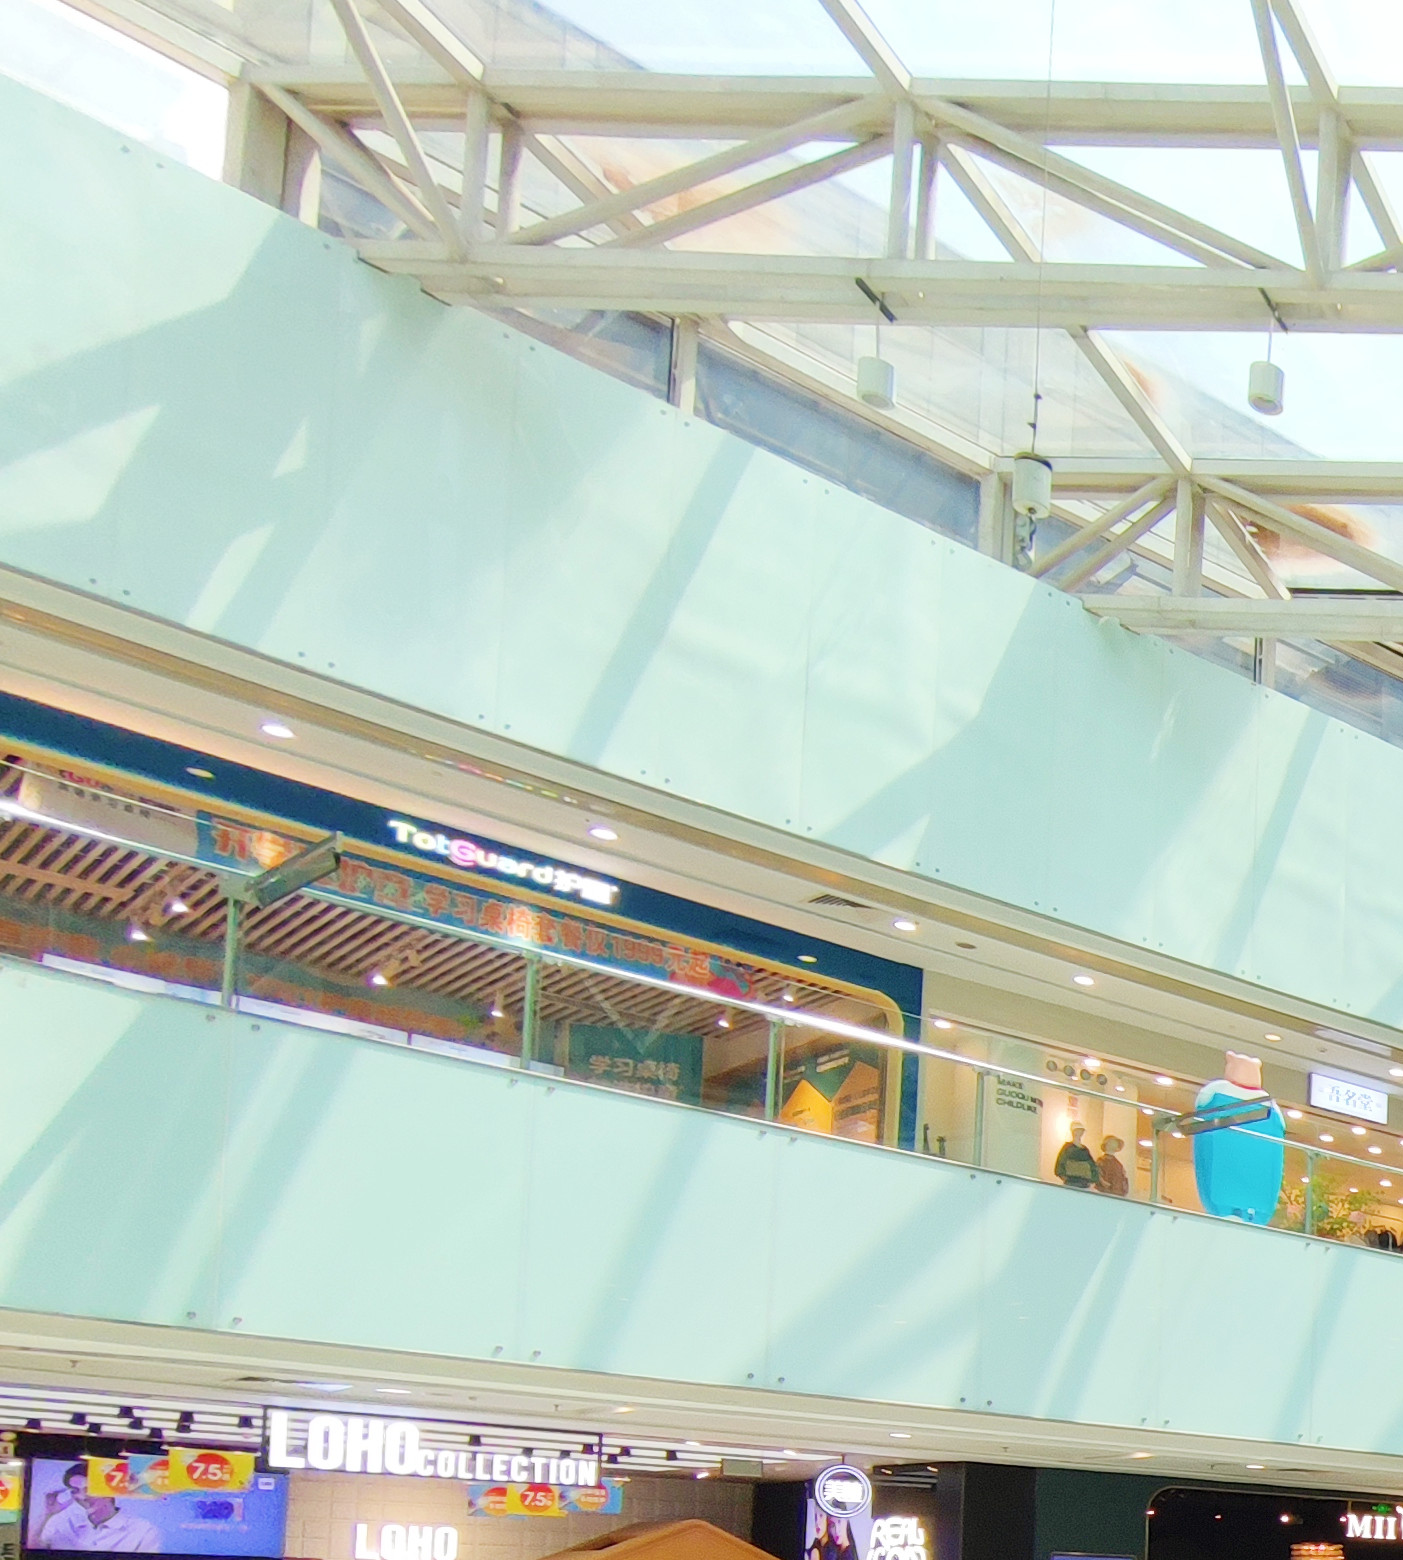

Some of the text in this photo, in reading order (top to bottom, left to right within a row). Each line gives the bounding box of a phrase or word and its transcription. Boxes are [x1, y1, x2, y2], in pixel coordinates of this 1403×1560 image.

[269, 1411, 596, 1486] LOHO COLLECTION
[871, 1517, 925, 1549] REAL
